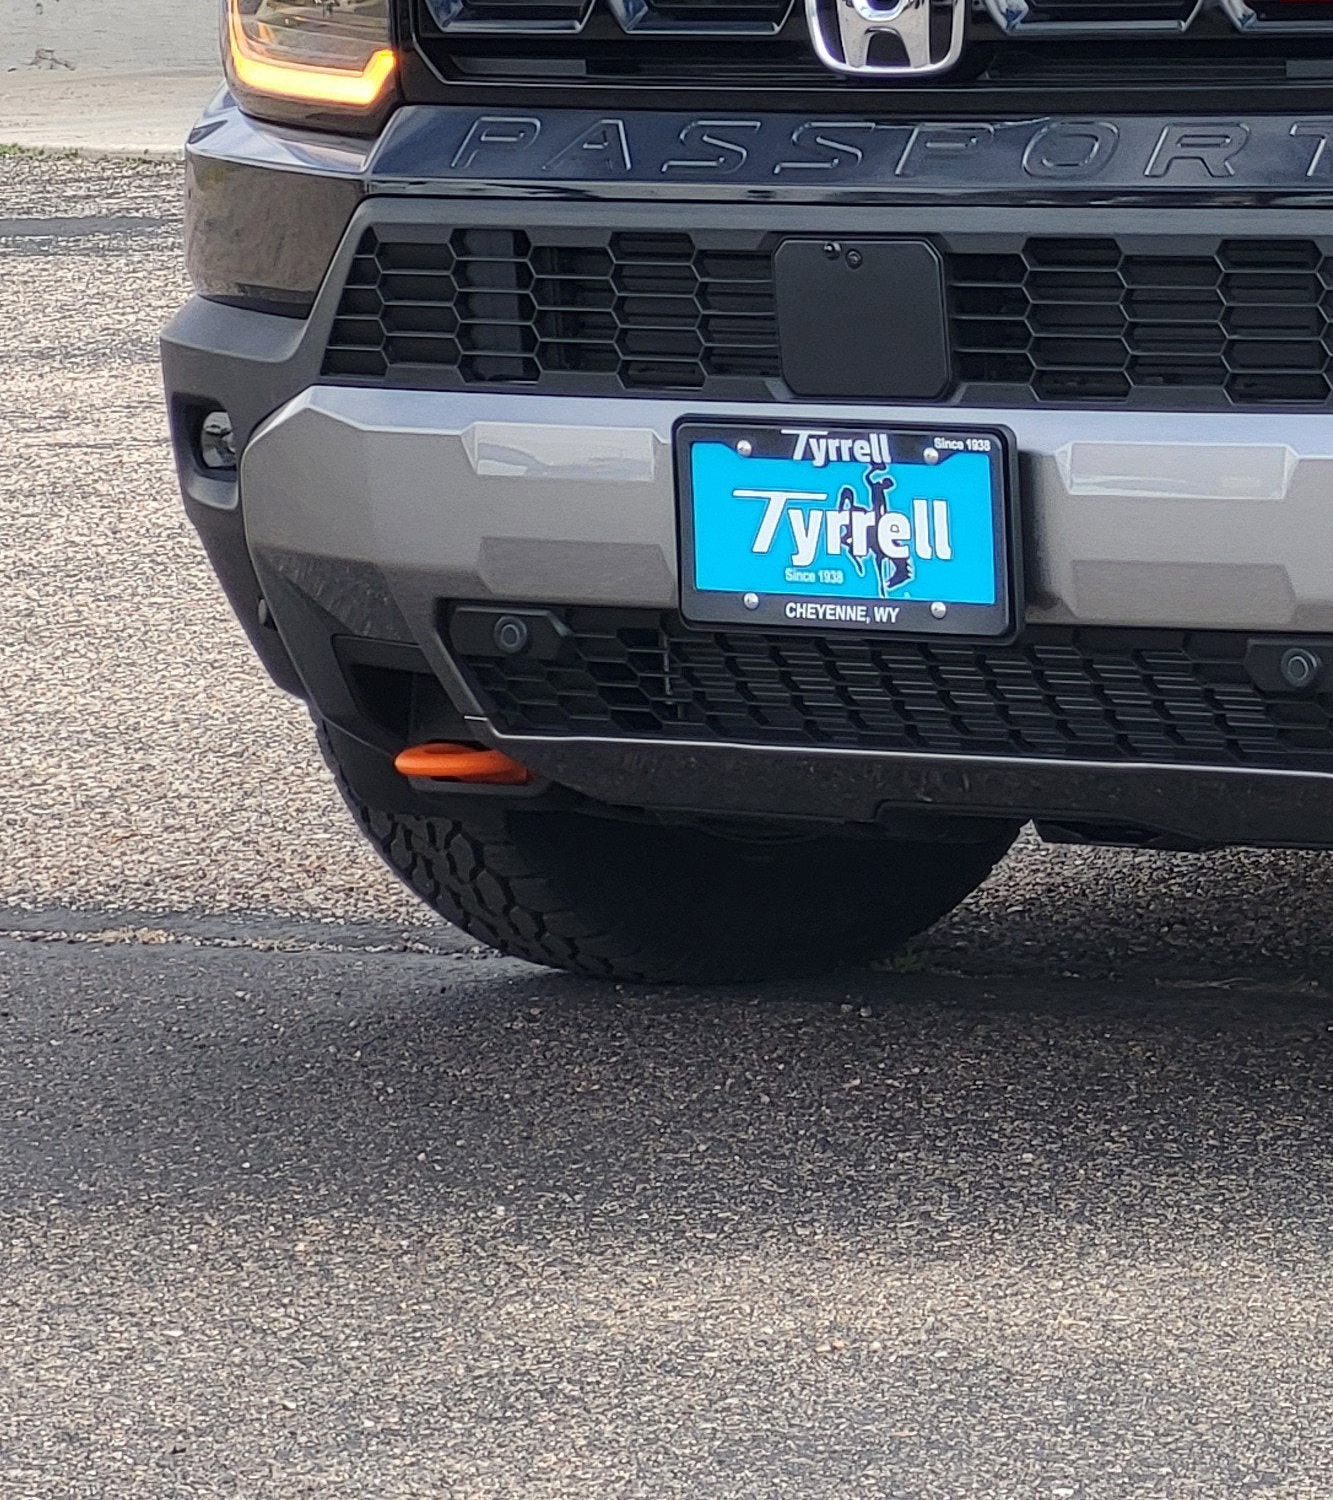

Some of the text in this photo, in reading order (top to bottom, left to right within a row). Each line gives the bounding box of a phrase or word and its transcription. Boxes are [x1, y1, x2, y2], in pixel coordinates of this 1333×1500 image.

[780, 429, 891, 468] Tyrrell
[933, 437, 991, 451] Since 1938
[733, 488, 953, 567] Tyrrell
[784, 568, 844, 584] Since 1938
[785, 602, 900, 624] CHEYENNE, WY
